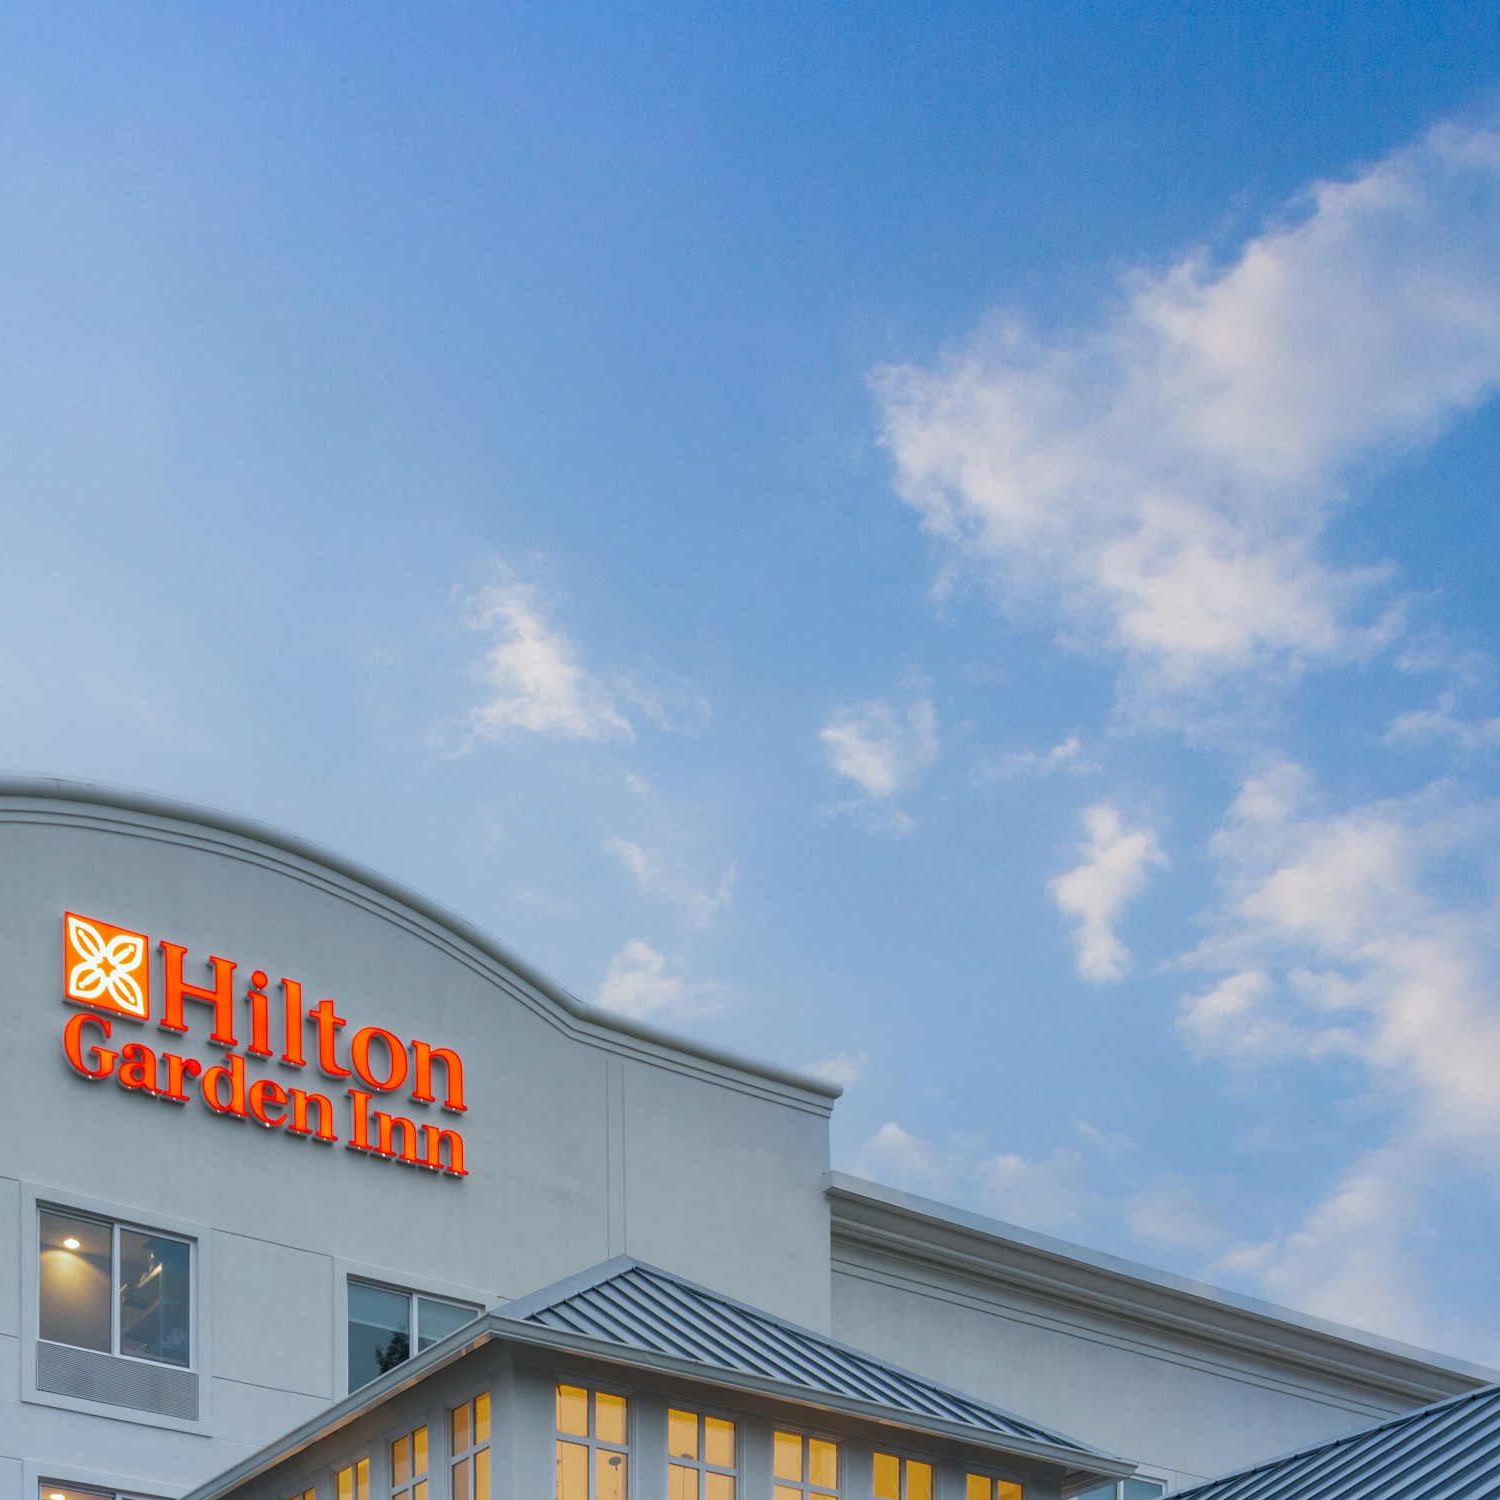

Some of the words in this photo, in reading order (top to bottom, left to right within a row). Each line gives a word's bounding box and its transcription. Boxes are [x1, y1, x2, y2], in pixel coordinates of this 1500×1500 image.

[62, 1012, 339, 1143] Garden
[347, 1088, 469, 1178] Inn
[159, 939, 468, 1114] Hilton
